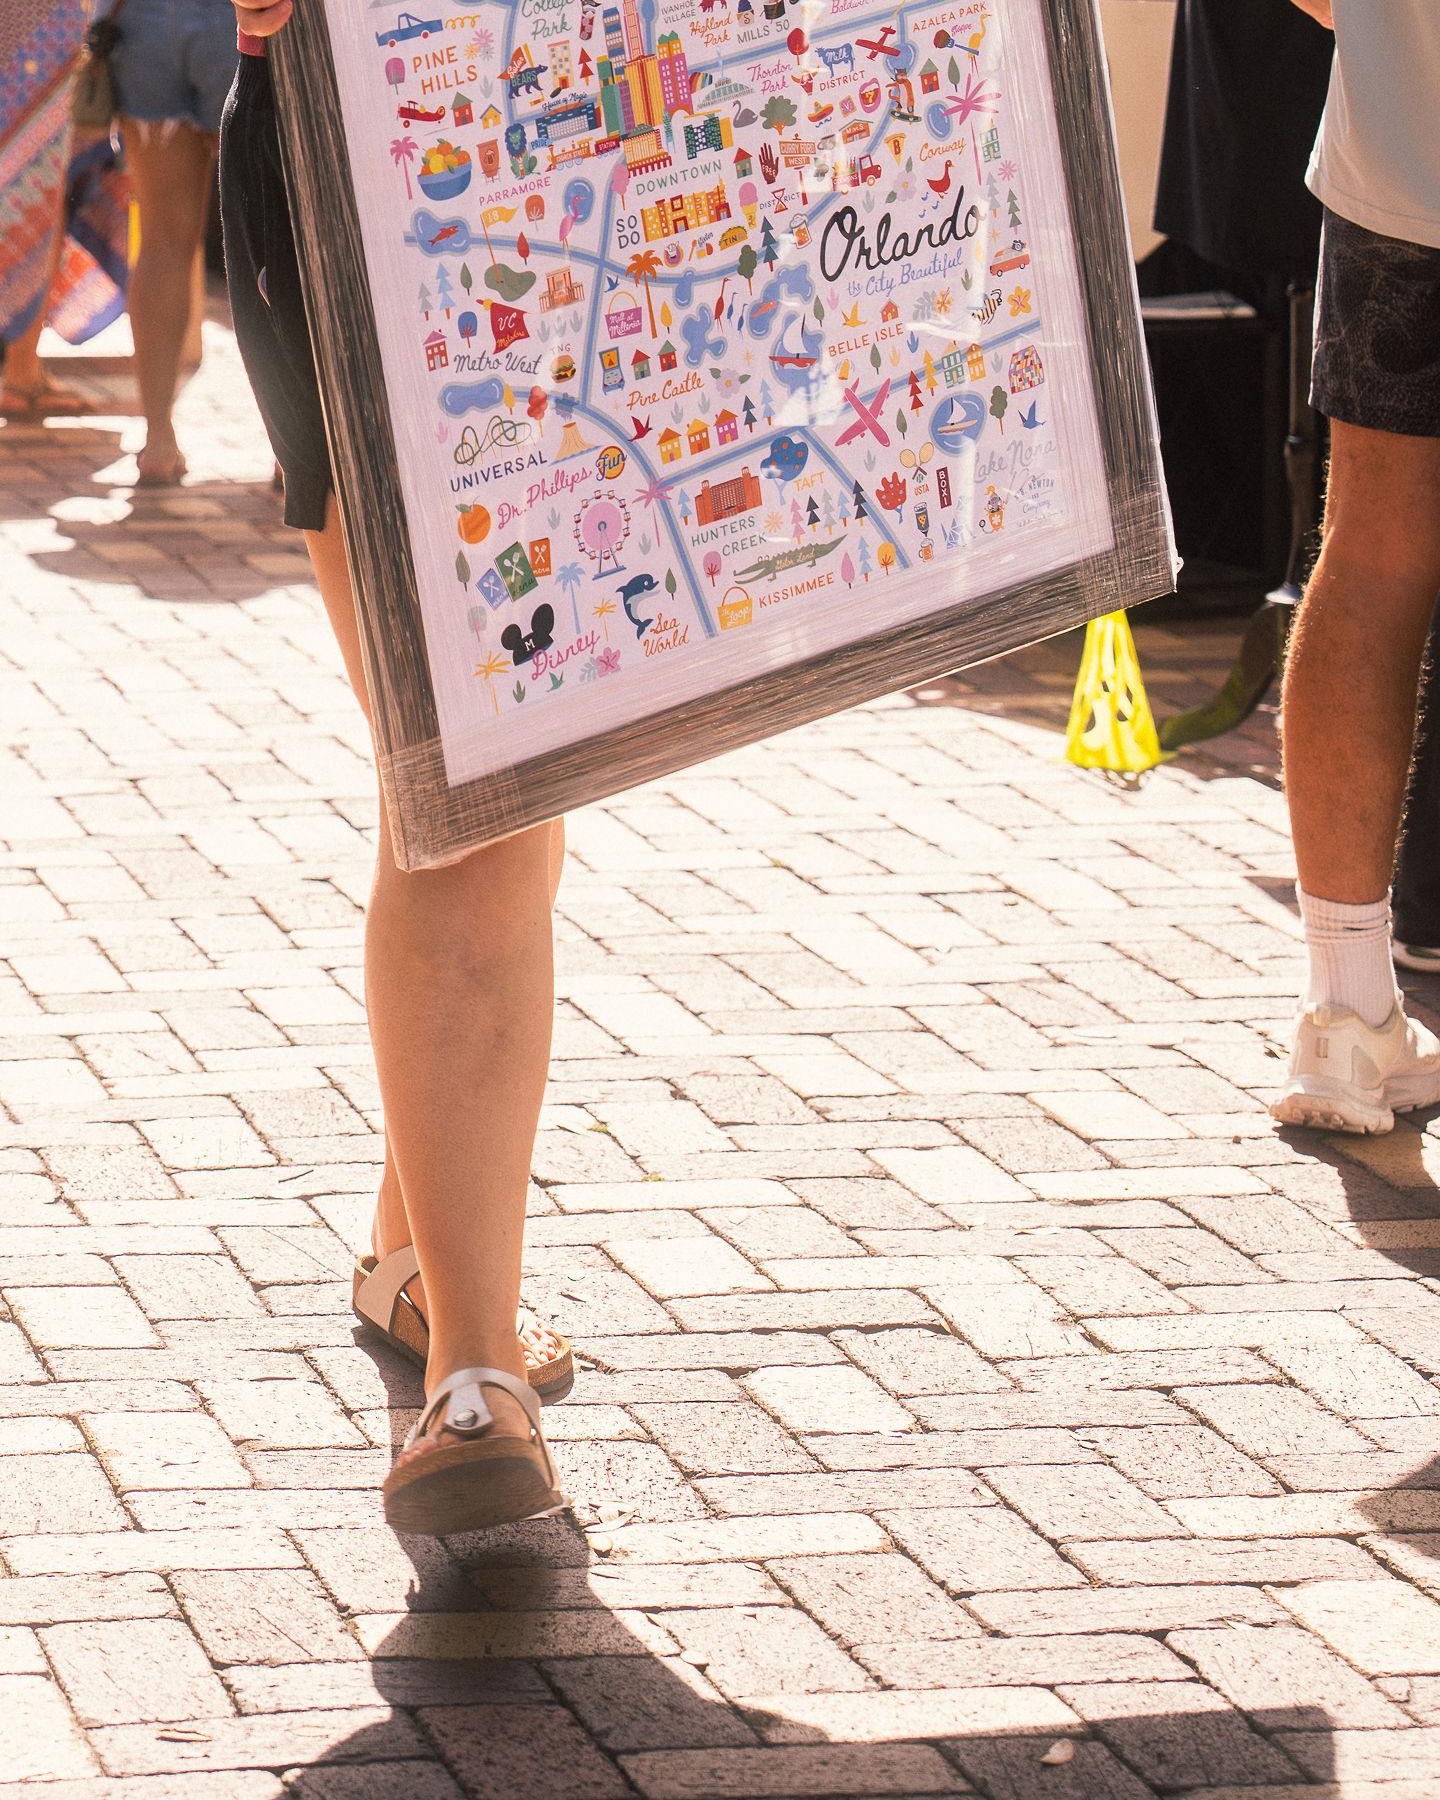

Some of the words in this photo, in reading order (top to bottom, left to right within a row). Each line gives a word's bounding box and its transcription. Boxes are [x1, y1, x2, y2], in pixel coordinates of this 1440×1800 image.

[661, 0, 696, 16] IVANHOE
[664, 8, 697, 25] VILLAGE
[913, 11, 958, 33] AZALEA
[959, 1, 988, 19] PARK
[531, 13, 573, 41] Park
[689, 11, 733, 37] Highland
[737, 23, 771, 45] MILLS
[775, 18, 791, 33] 50
[703, 29, 731, 48] Park
[412, 45, 459, 73] PINE
[746, 58, 793, 83] Thornton
[421, 64, 478, 96] HILLS
[760, 77, 789, 96] Park
[819, 70, 866, 92] DISTRICT
[919, 137, 967, 162] Conway
[479, 176, 552, 207] PARRAMORE
[635, 159, 723, 196] DOWNTOWN
[616, 215, 638, 233] SO
[819, 185, 988, 282] Orlando
[617, 231, 641, 250] DO
[865, 270, 897, 301] City
[898, 247, 964, 287] Beautiful
[828, 333, 870, 358] BELLE
[874, 322, 905, 343] ISLE
[453, 350, 502, 374] Metro
[505, 351, 543, 376] West
[626, 390, 660, 411] Pine
[661, 371, 705, 401] Castle
[449, 450, 548, 493] UNIVERSAL
[595, 451, 628, 482] Fun
[526, 468, 594, 509] Phillips
[793, 471, 826, 492] TAFT
[691, 515, 756, 548] HUNTERS
[721, 532, 767, 557] CREEK
[759, 571, 836, 609] KISSIMMEE
[649, 612, 681, 635] Sea
[642, 624, 691, 658] World
[531, 630, 602, 681] Disney
